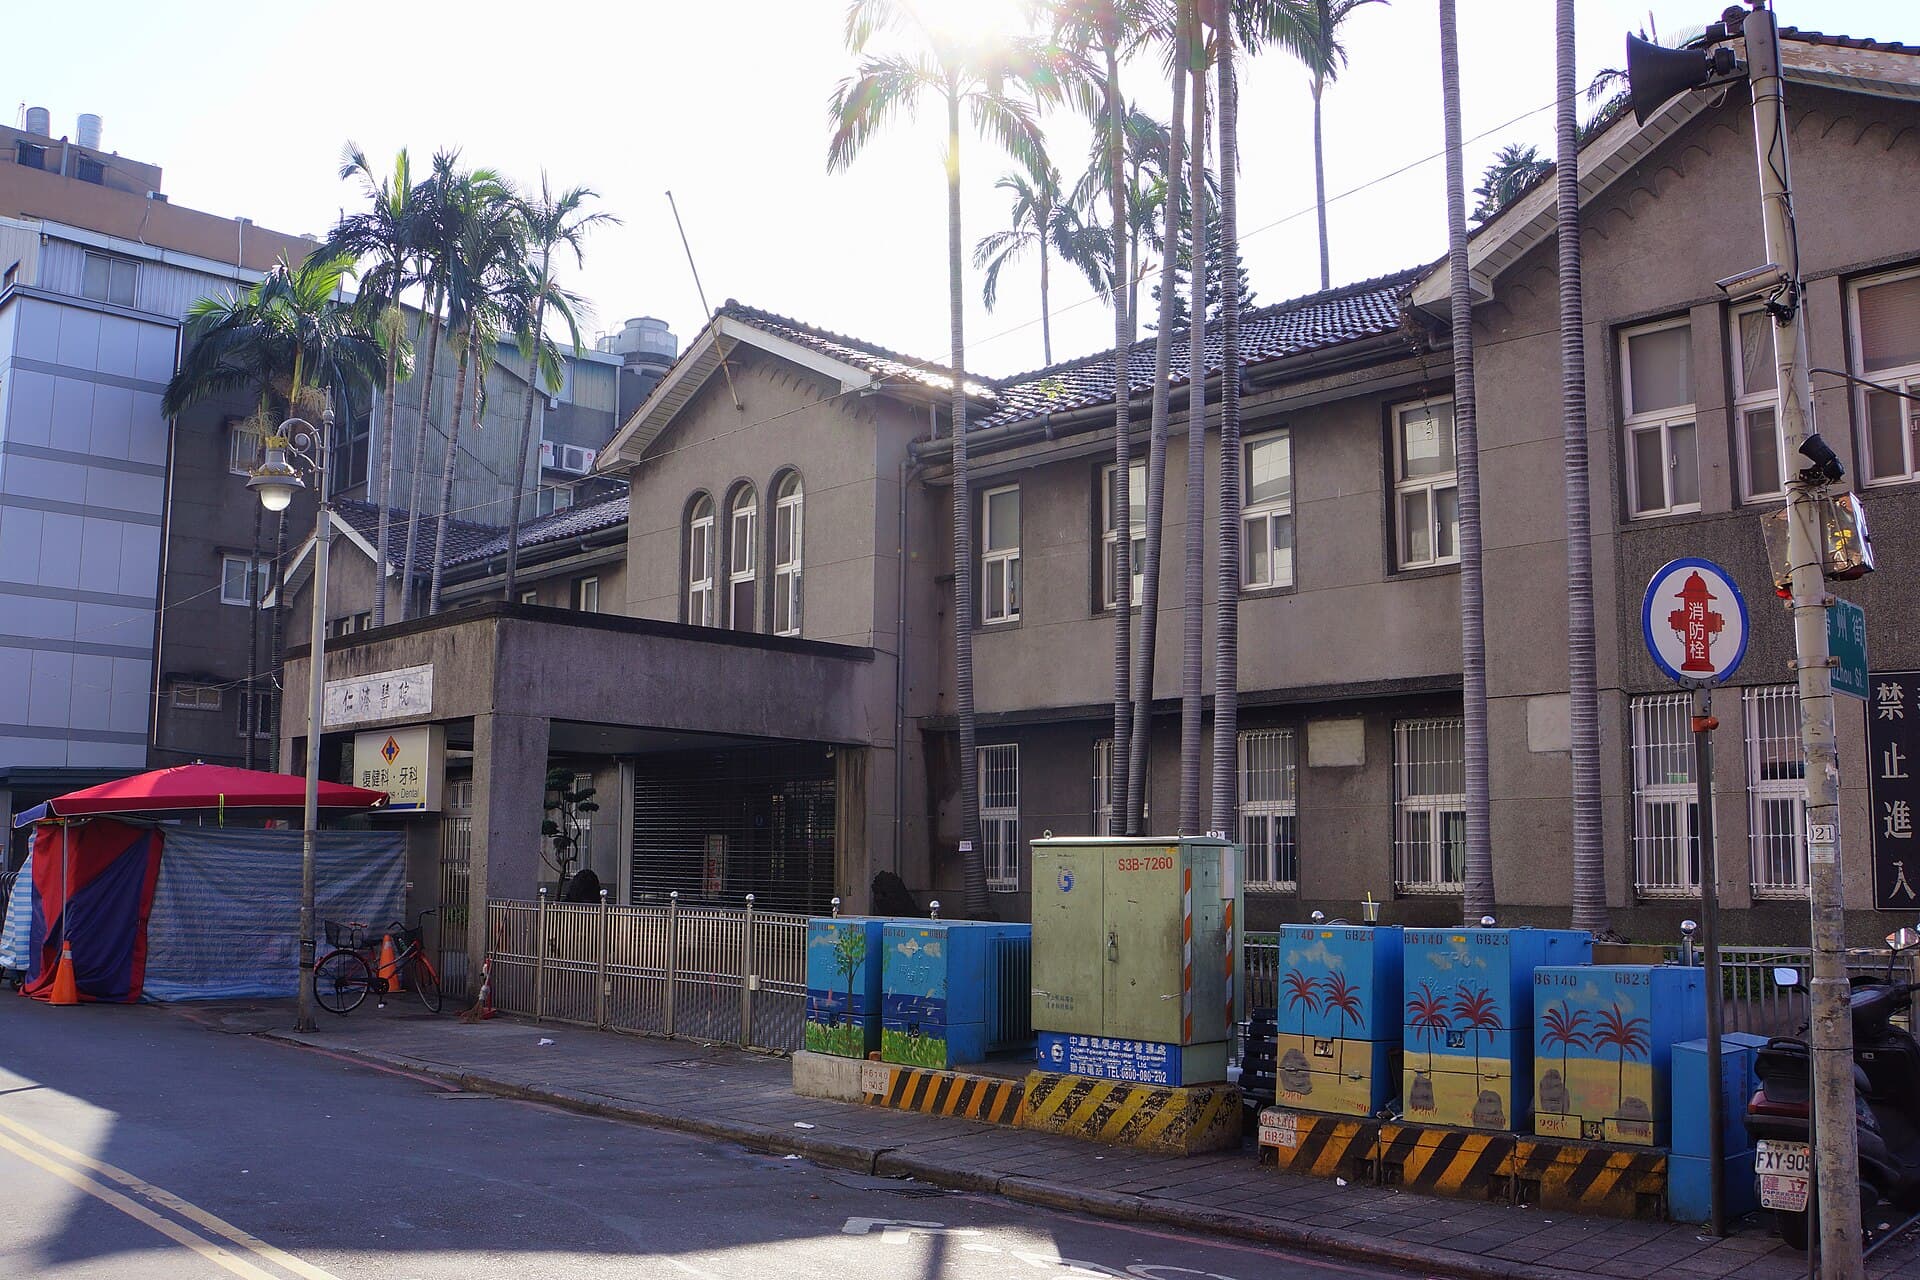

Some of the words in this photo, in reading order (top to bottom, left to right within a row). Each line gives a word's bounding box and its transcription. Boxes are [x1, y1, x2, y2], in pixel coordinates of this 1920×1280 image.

[1688, 601, 1706, 660] 消防栓
[1826, 605, 1863, 648] 州街
[342, 680, 410, 713] 仁濟醫院
[400, 788, 420, 799] Dental
[1876, 682, 1917, 900] 禁止進入
[1118, 856, 1173, 871] S3B-7260
[1345, 929, 1375, 941] GB23
[1475, 934, 1509, 946] GB23
[1615, 972, 1650, 986] GB23
[1069, 1036, 1167, 1056] 中華電信台北營運處
[1264, 1130, 1292, 1144] GB23
